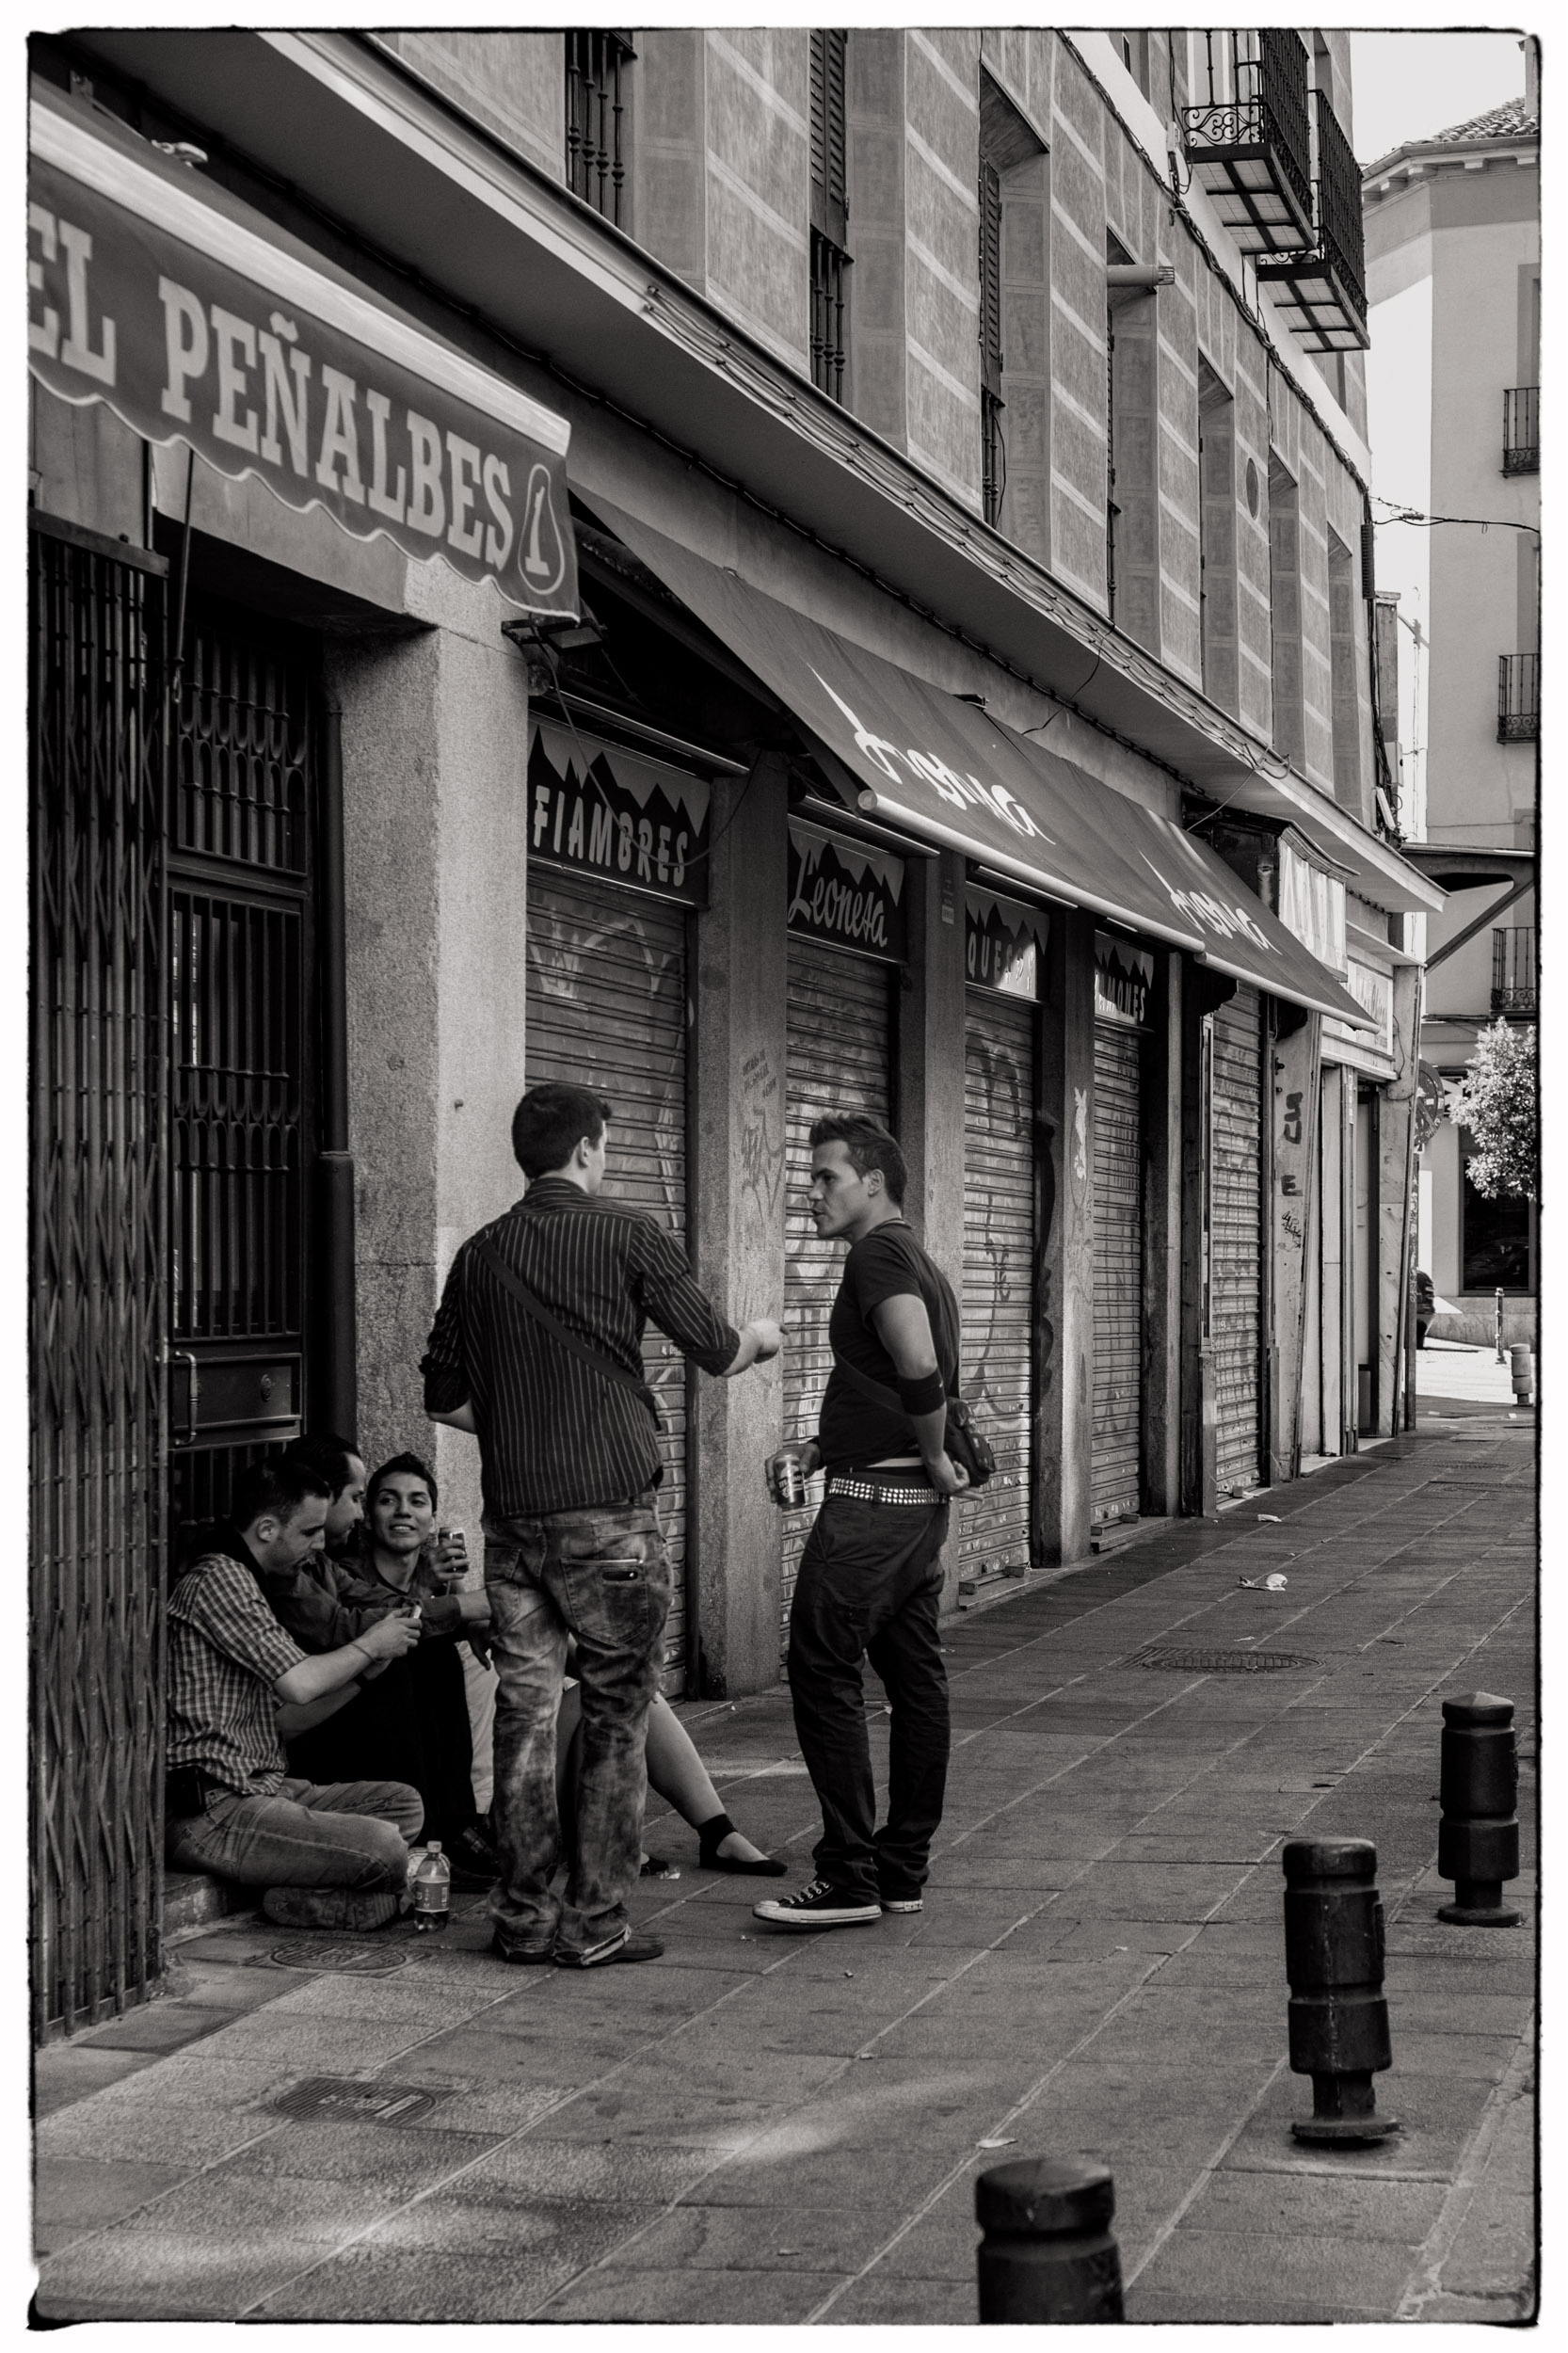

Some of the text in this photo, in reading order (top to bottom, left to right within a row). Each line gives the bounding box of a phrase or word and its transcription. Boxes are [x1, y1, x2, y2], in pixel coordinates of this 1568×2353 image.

[158, 276, 514, 571] PEÑALBES
[534, 784, 688, 888] FIAMBRES
[788, 844, 888, 948] Leonesa
